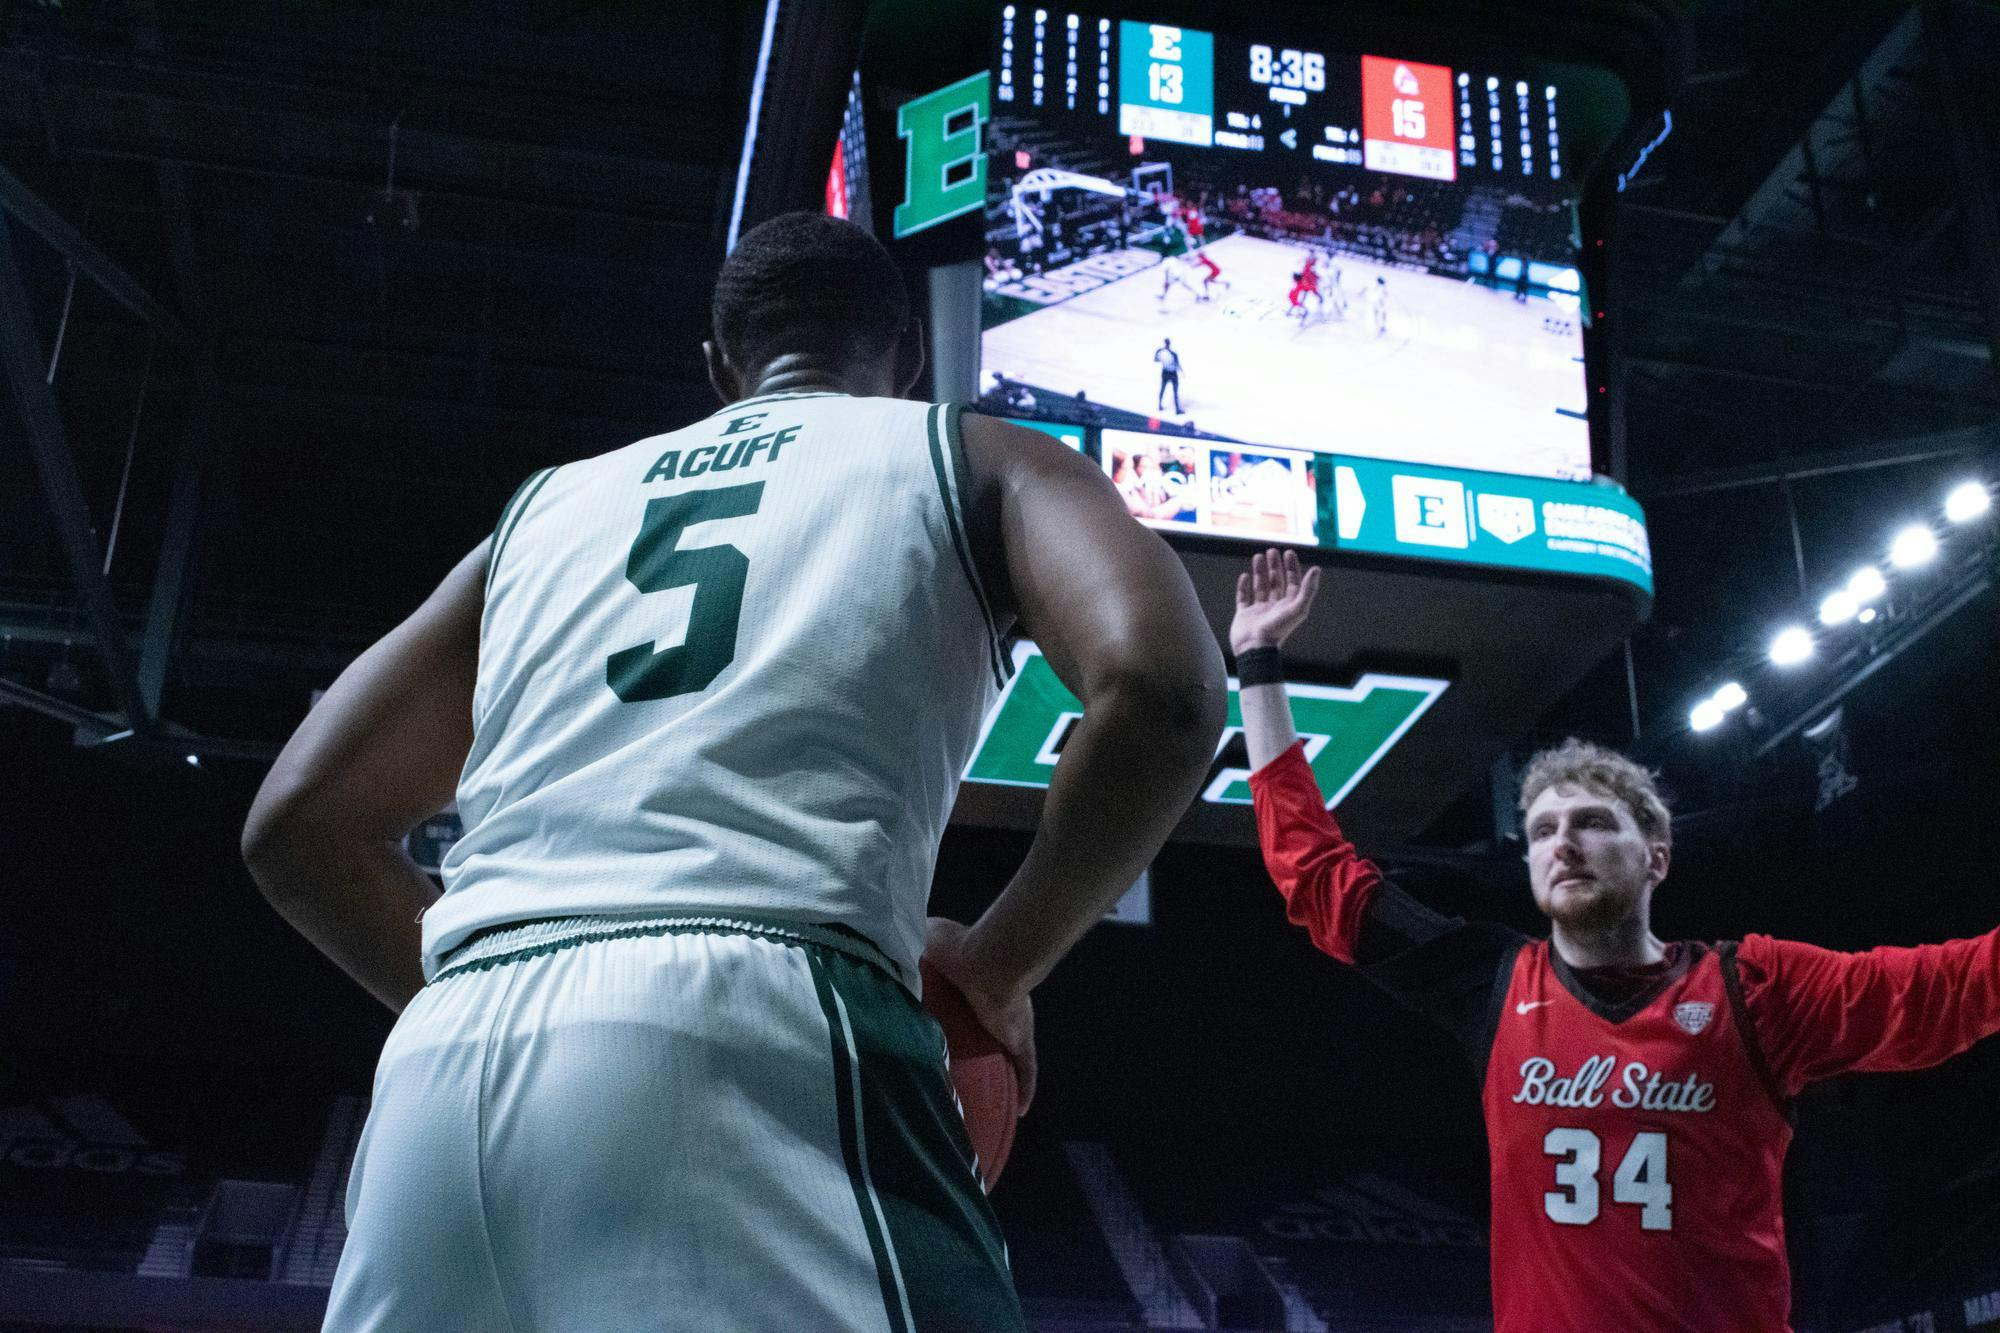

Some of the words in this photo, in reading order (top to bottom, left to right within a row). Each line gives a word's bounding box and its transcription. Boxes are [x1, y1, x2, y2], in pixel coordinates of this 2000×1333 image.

[1149, 24, 1182, 61] E
[1148, 62, 1183, 104] 13
[1250, 44, 1325, 91] 8:36
[1391, 98, 1425, 139] 15
[894, 69, 990, 239] E
[719, 412, 769, 436] E
[641, 424, 803, 484] ACUFF
[1414, 494, 1446, 528] E
[606, 480, 766, 704] 5
[1512, 1055, 1616, 1108] Ball
[1611, 1062, 1716, 1112] State
[1544, 1127, 1673, 1230] 34
